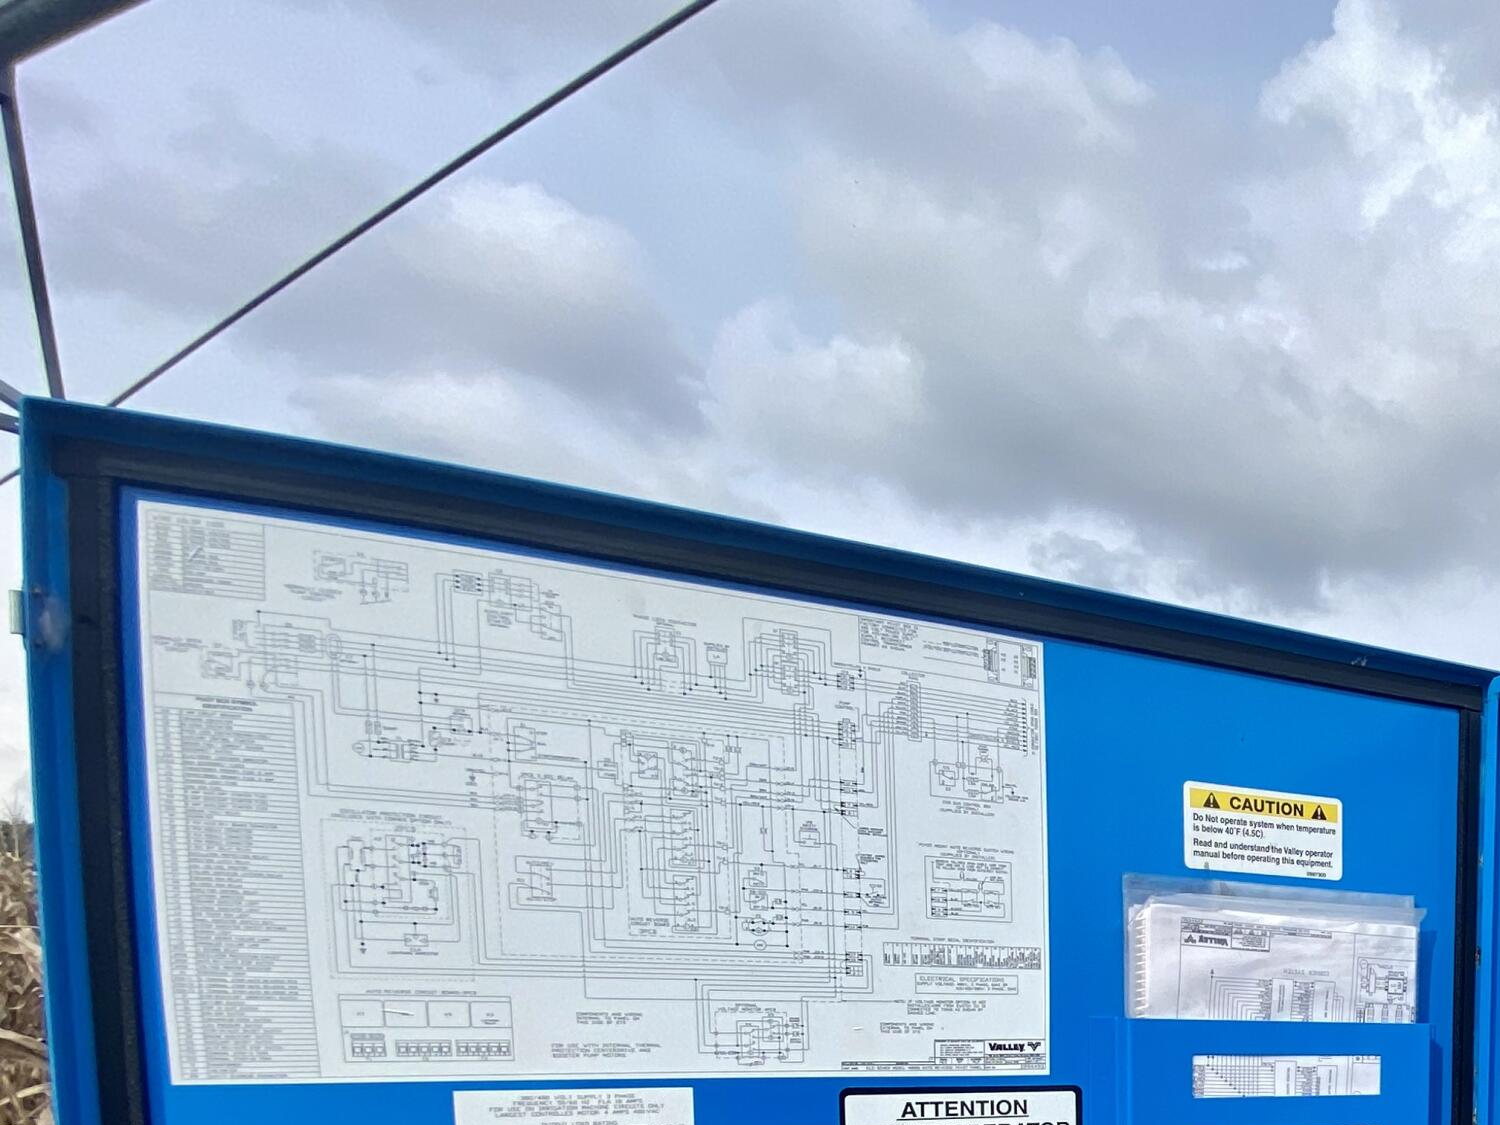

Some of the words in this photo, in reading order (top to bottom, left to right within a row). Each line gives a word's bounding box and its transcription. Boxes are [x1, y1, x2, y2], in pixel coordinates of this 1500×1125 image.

[1230, 797, 1303, 816] CAUTION
[1193, 813, 1203, 821] Do
[1206, 815, 1218, 823] Not
[1220, 817, 1247, 827] operate
[1250, 821, 1274, 829] system
[1276, 823, 1294, 831] when
[1296, 824, 1336, 834] temperature
[1202, 824, 1223, 834] below
[1194, 839, 1212, 847] Read
[1214, 840, 1227, 848] and
[1230, 842, 1269, 852] understand
[1272, 844, 1282, 853] the
[1284, 845, 1303, 856] Valley
[1305, 849, 1333, 858] operator
[1193, 850, 1220, 858] manual
[1222, 851, 1244, 860] before
[1247, 853, 1280, 865] operating
[1282, 855, 1294, 864] this
[1296, 858, 1333, 868] equipment.
[989, 1043, 1024, 1052] VALLEY
[901, 1100, 1028, 1118] ATTENTION
